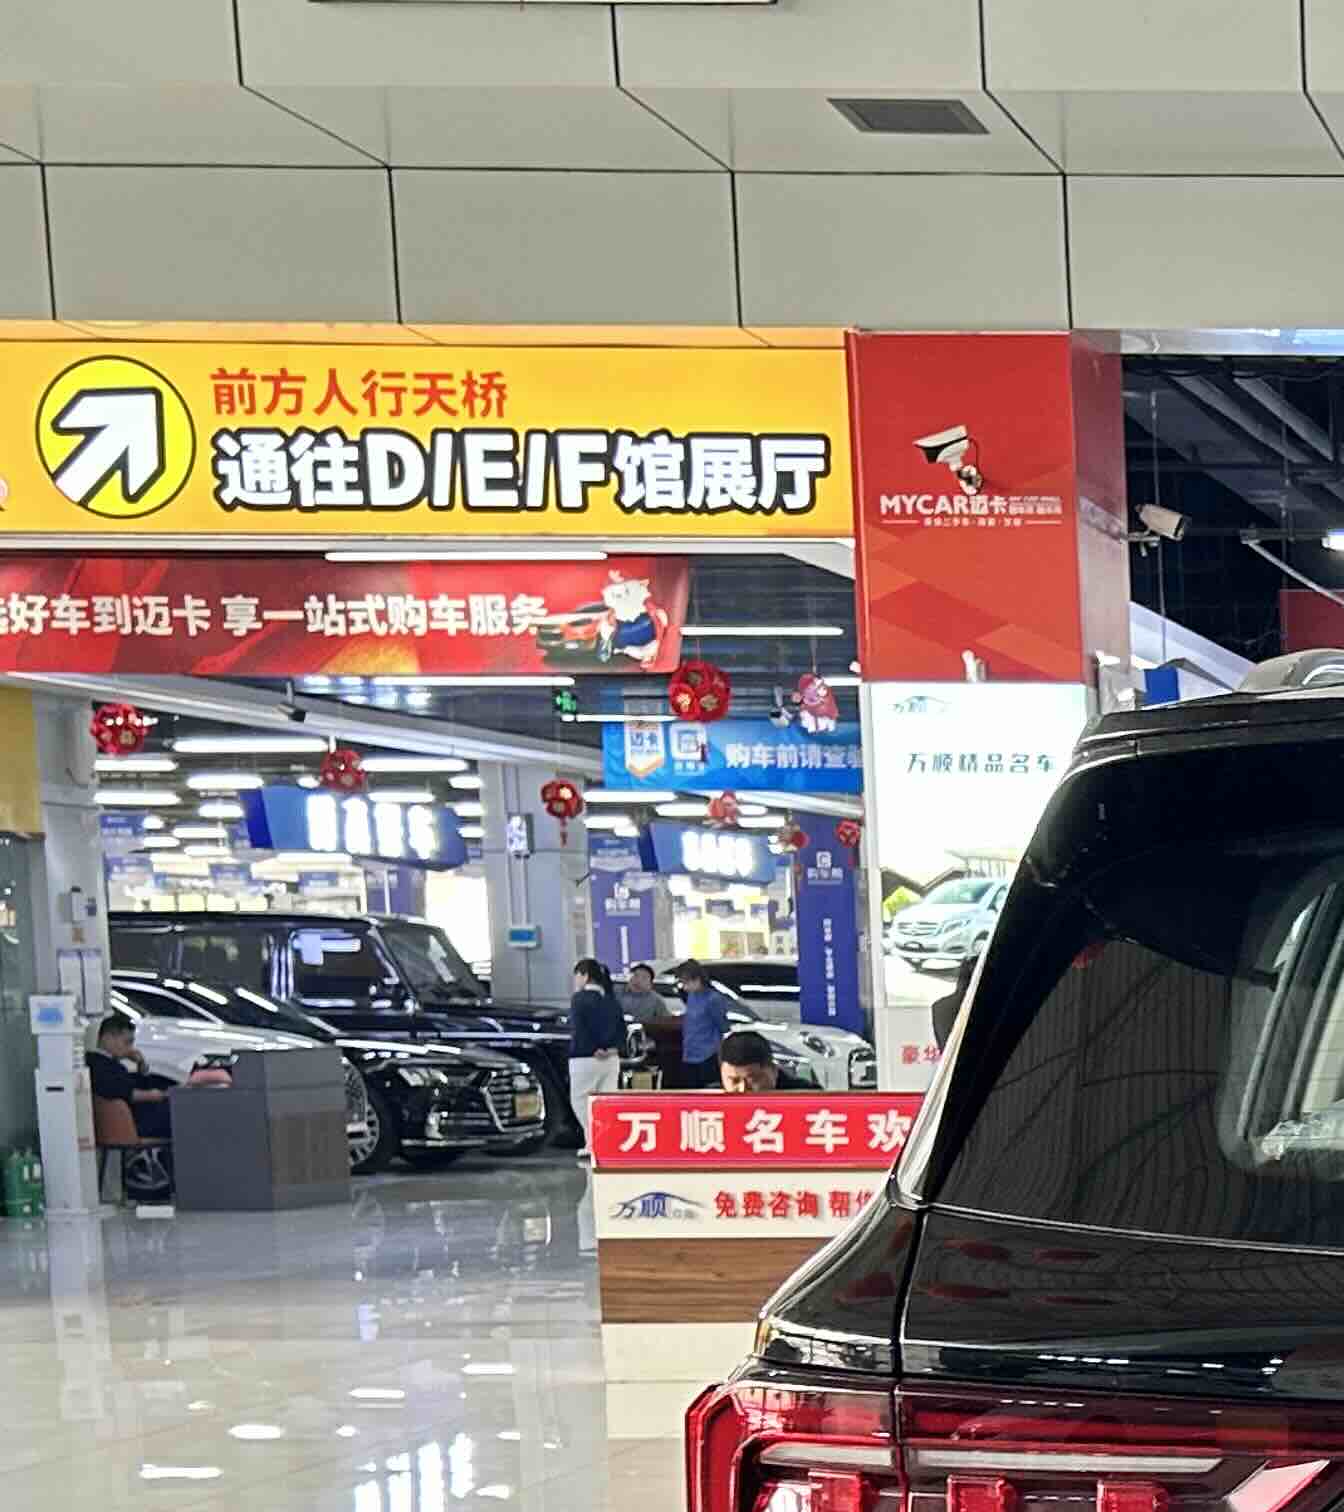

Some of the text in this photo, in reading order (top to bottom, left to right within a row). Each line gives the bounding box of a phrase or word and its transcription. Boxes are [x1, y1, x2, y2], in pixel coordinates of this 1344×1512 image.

[210, 368, 508, 418] 前方人行天桥
[213, 428, 829, 511] 通往D/E/F馆展厅
[222, 594, 549, 637] 享一站式购车服务
[907, 751, 1056, 774] 万顺精品名车
[617, 1108, 912, 1153] 万顺名车欢
[714, 1190, 820, 1218] 免费咨询
